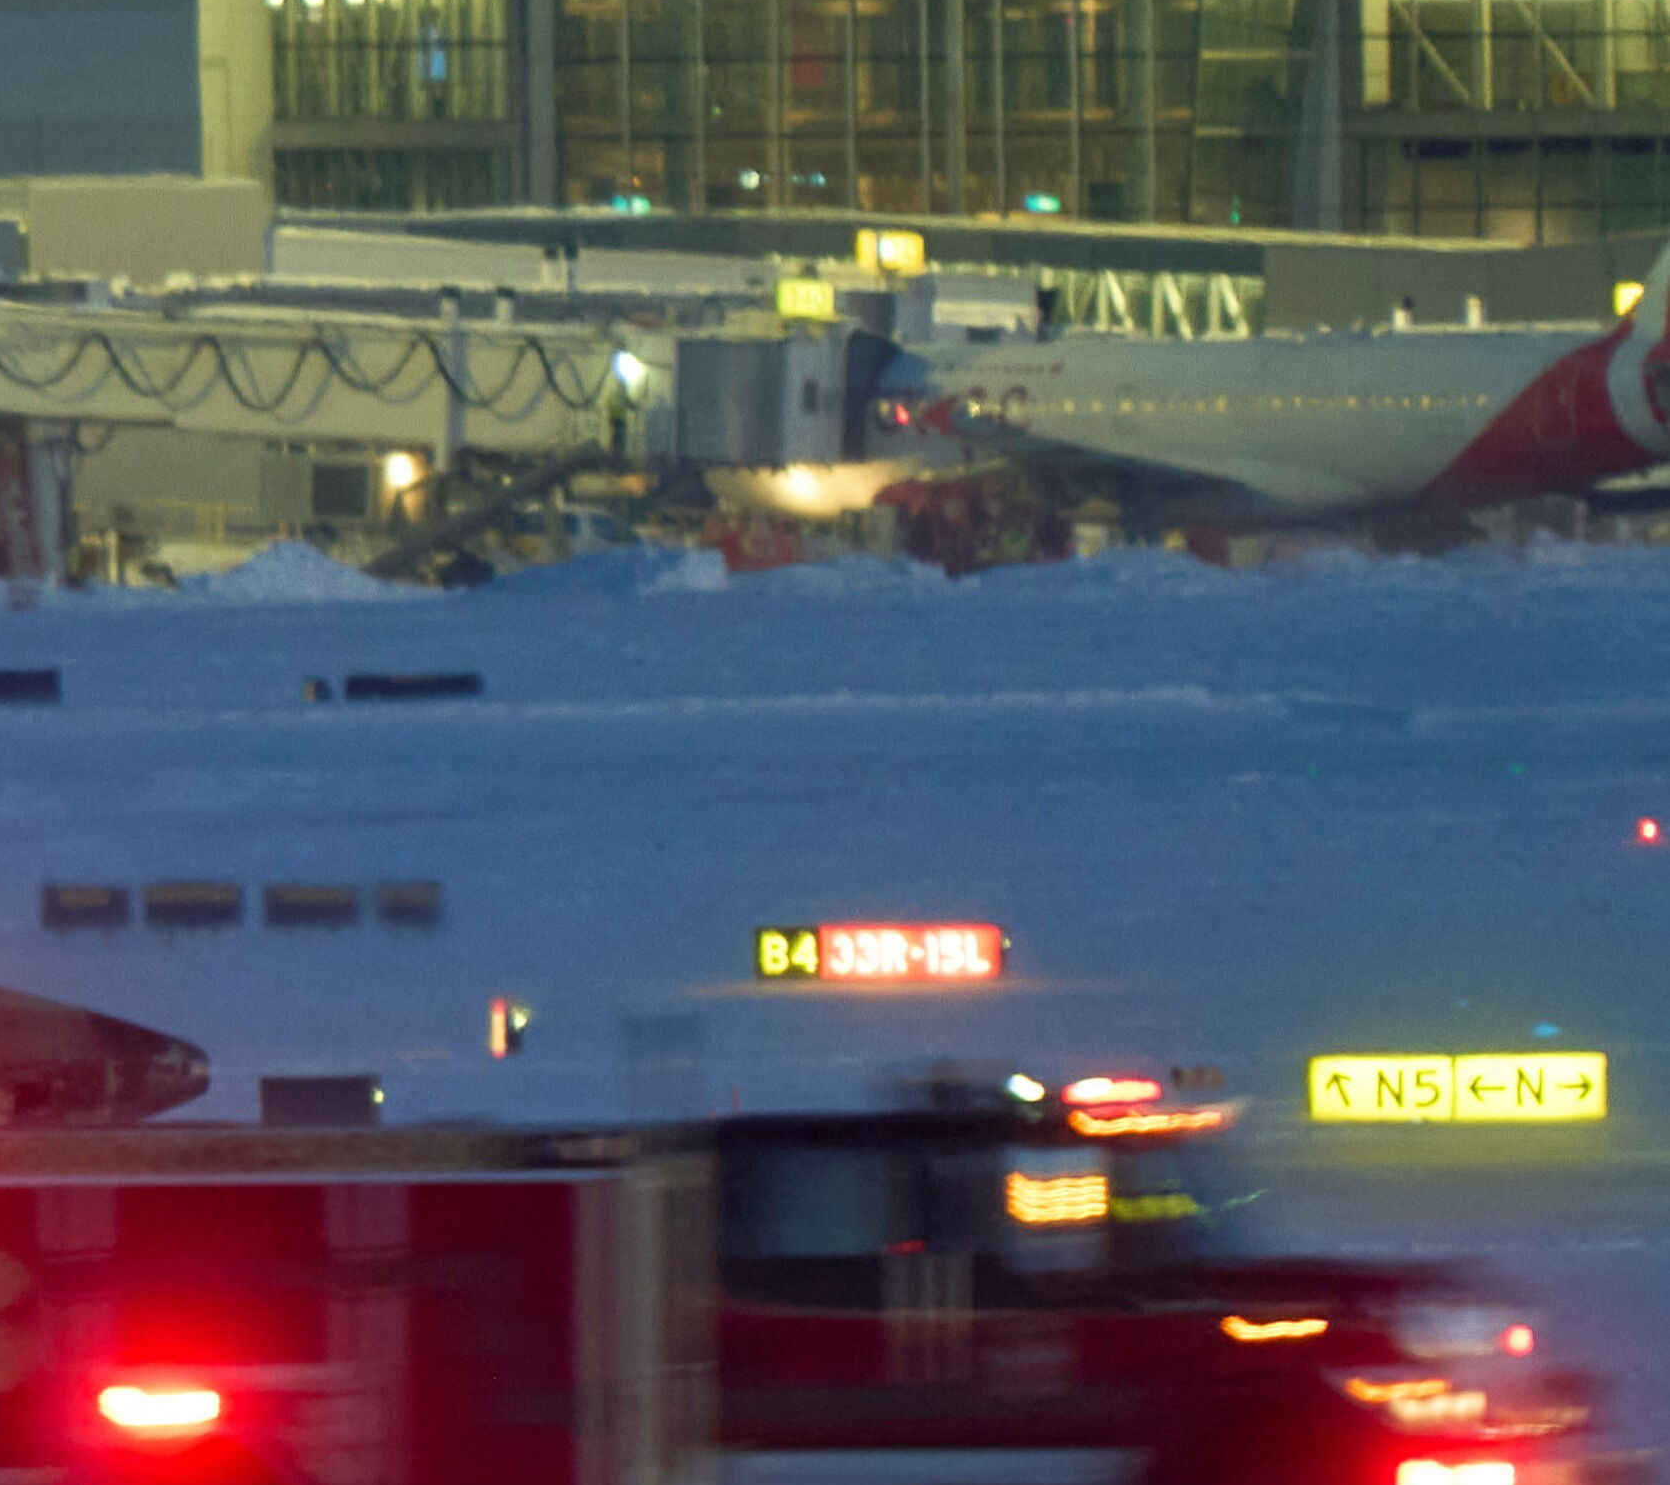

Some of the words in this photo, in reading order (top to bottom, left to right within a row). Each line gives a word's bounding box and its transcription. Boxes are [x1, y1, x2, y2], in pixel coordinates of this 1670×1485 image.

[760, 931, 818, 975] B4
[1376, 1069, 1439, 1108] N5
[1517, 1067, 1544, 1106] N
